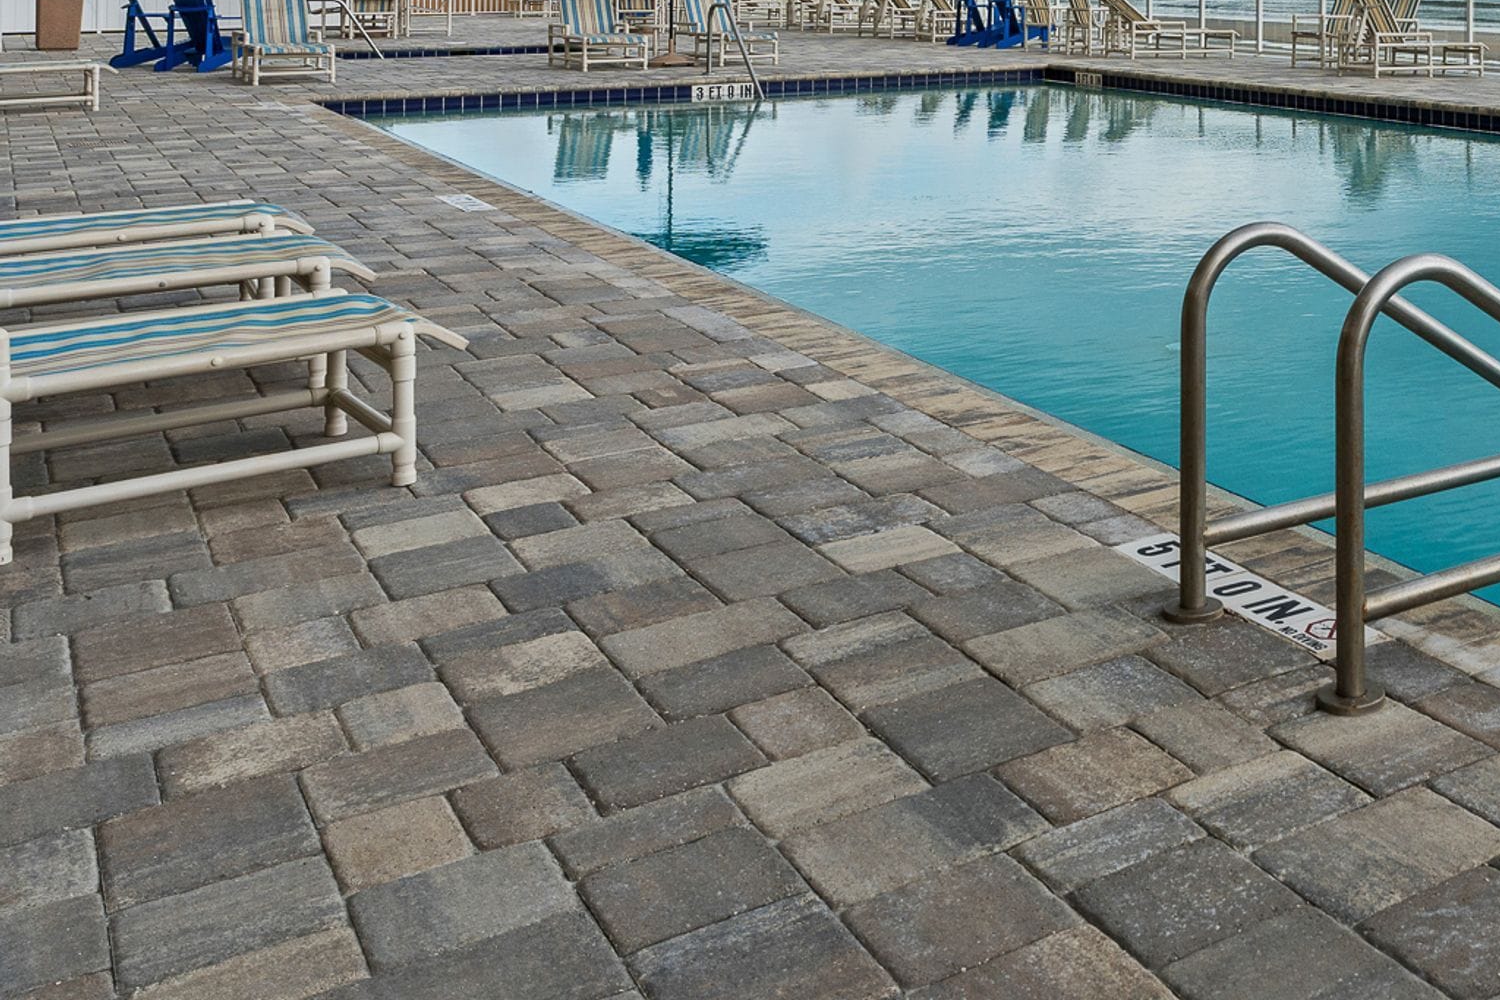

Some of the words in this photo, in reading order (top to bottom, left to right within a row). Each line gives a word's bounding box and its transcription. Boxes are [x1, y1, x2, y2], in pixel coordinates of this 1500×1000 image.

[1136, 540, 1180, 557] 5
[1213, 580, 1263, 597] 0
[1241, 595, 1316, 624] IN.
